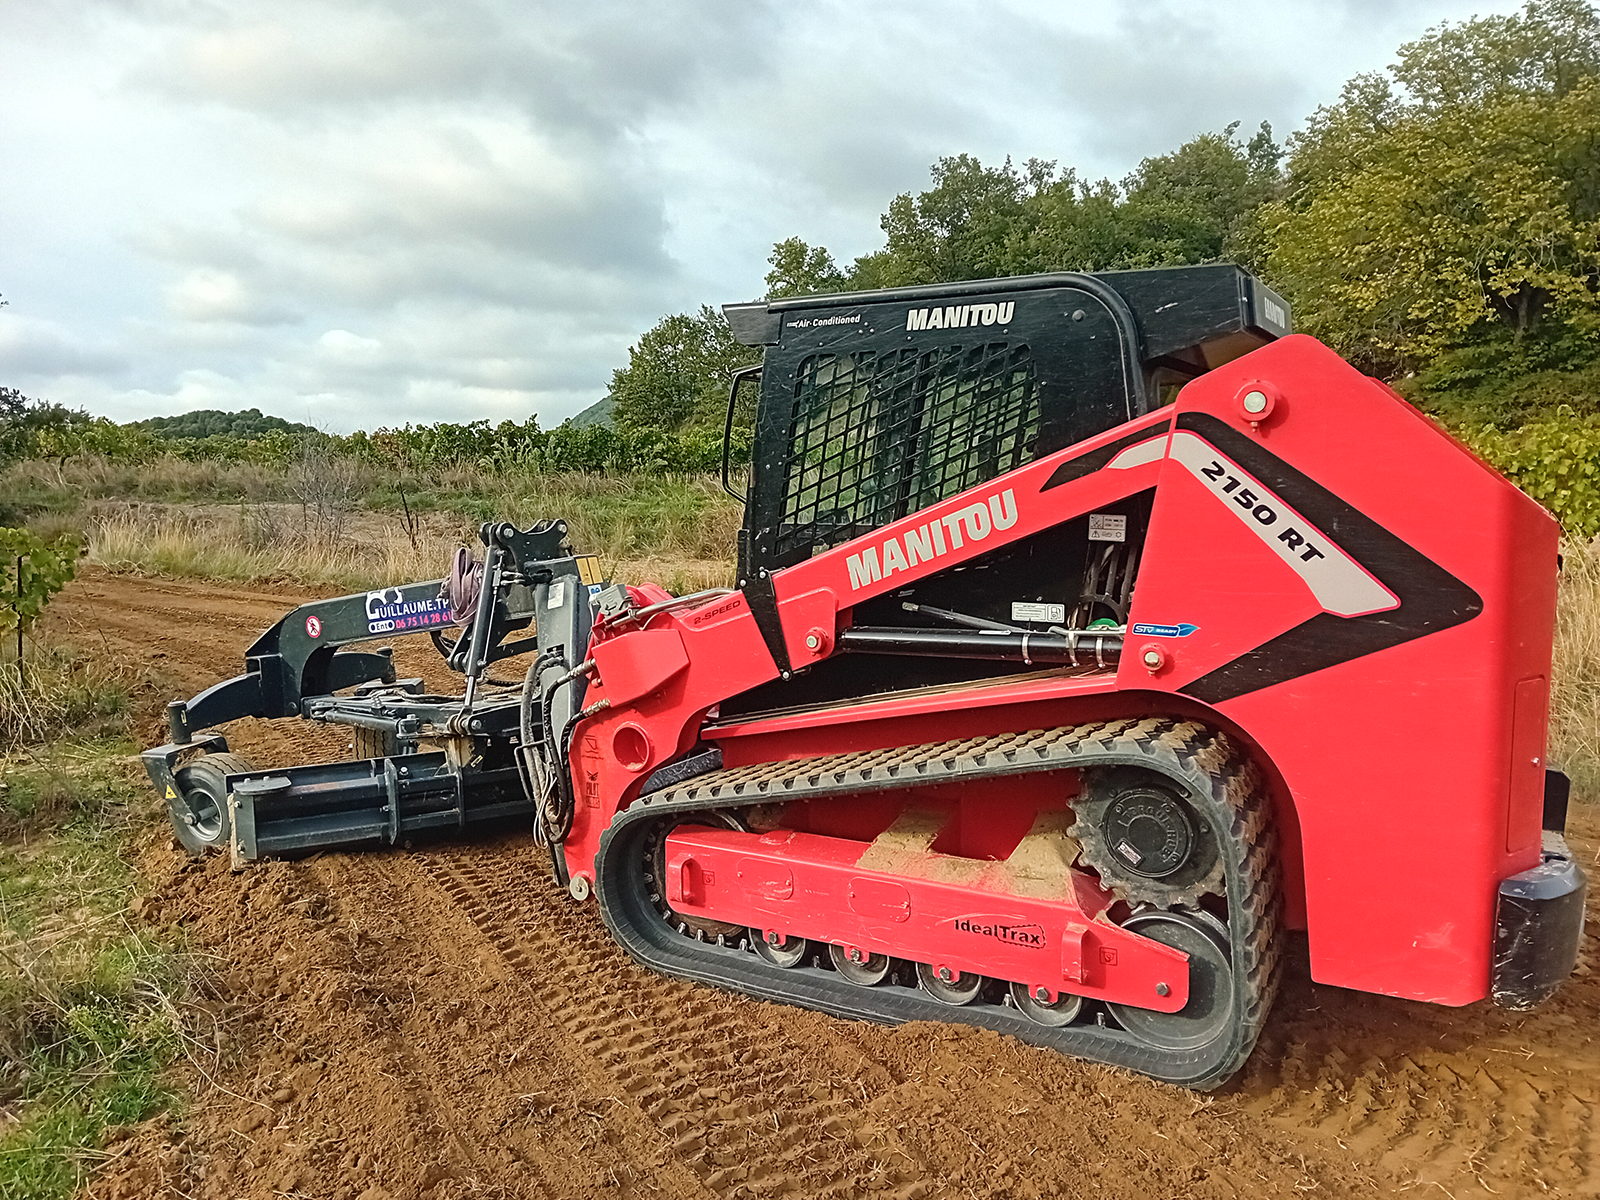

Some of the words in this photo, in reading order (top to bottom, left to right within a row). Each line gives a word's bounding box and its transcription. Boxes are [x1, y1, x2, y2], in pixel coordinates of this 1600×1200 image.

[906, 301, 1015, 331] MANITOU
[1200, 460, 1278, 526] 2150
[1277, 527, 1325, 562] RT
[846, 488, 1018, 591] MANITOU
[395, 619, 406, 629] 06
[407, 616, 417, 627] 75
[419, 614, 429, 625] 14
[430, 612, 441, 623] 28
[694, 600, 741, 625] 2-SPEED
[955, 919, 1040, 945] IdealTrax
